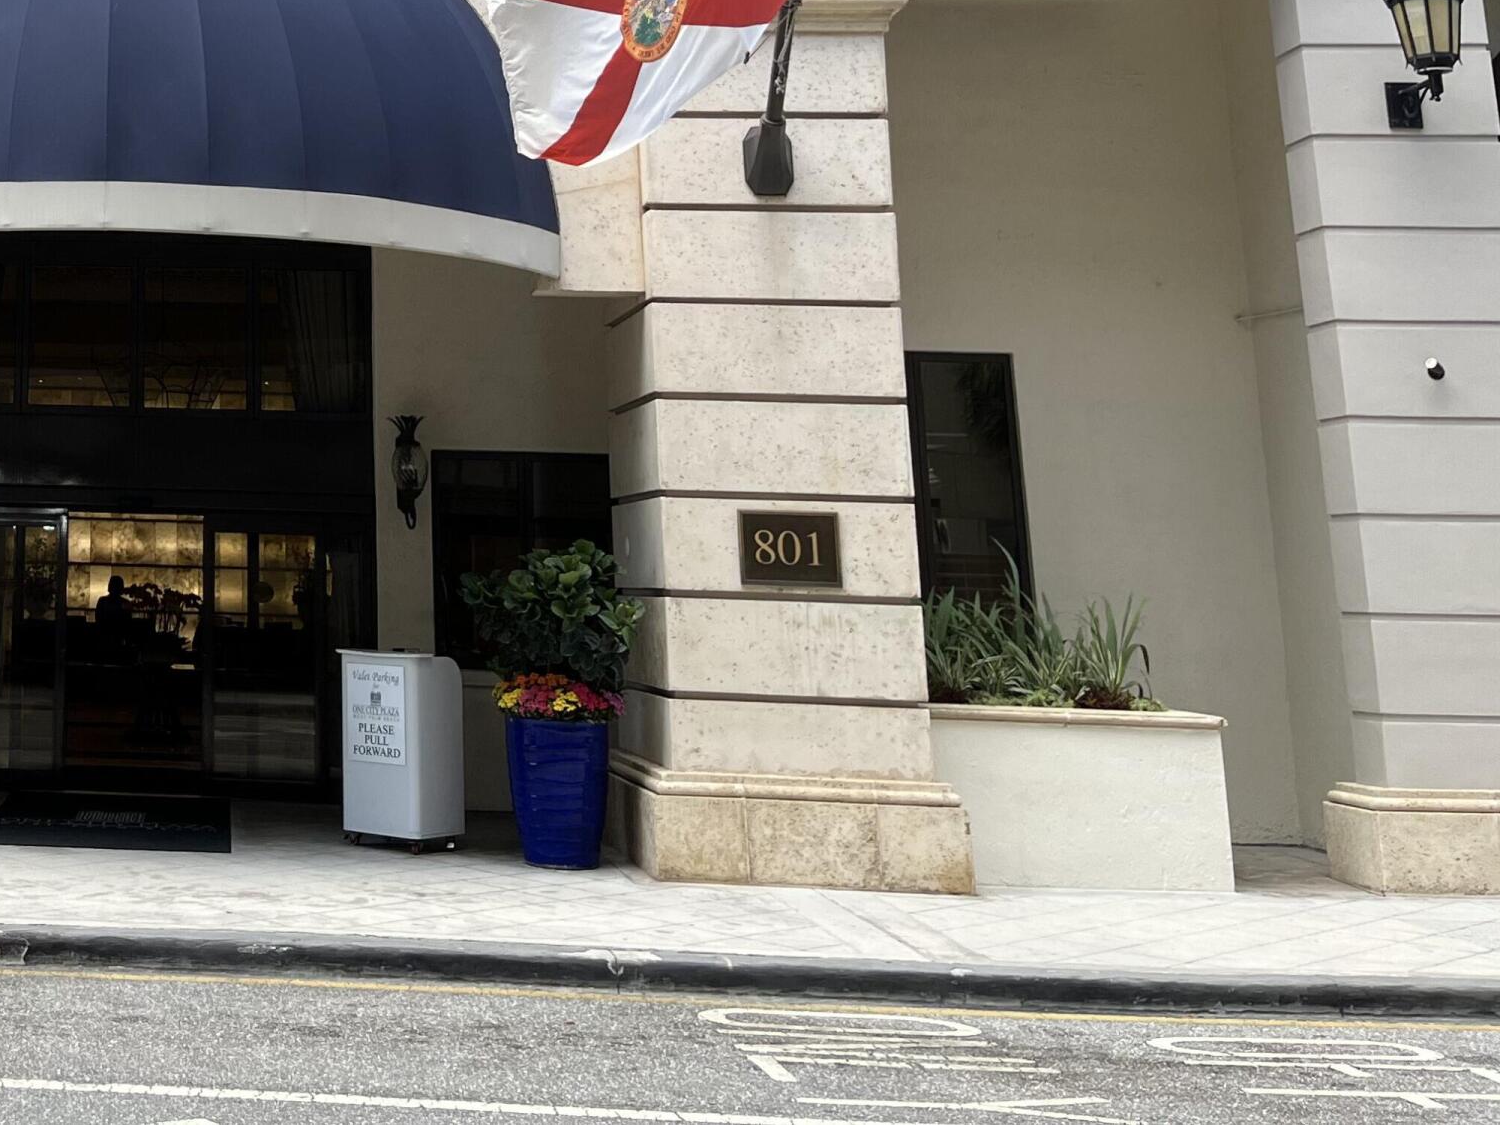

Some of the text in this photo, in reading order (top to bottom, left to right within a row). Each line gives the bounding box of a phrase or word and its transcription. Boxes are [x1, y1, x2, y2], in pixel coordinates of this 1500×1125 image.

[753, 529, 824, 567] 801
[371, 671, 399, 686] Parking
[380, 707, 400, 717] PLAZA
[358, 722, 395, 735] PLEASE
[364, 734, 389, 746] PULL
[353, 744, 401, 758] FORWARD
[698, 1008, 1148, 1125] ONLY
